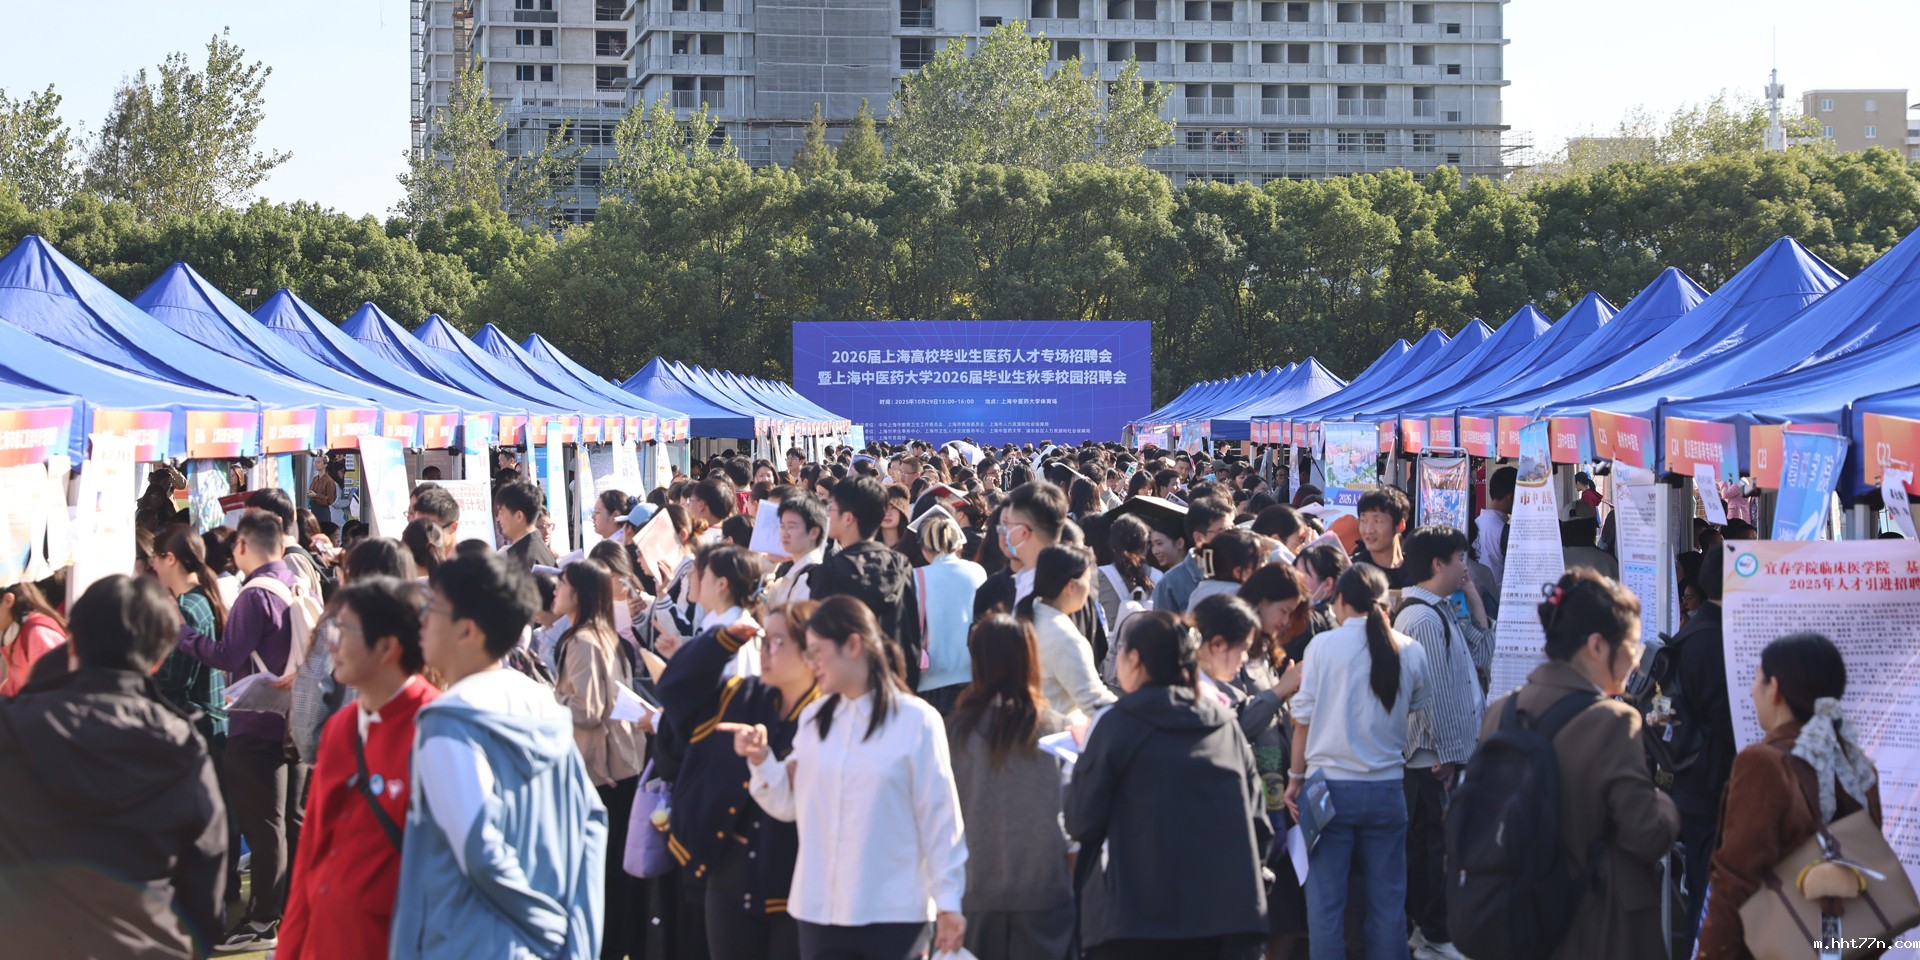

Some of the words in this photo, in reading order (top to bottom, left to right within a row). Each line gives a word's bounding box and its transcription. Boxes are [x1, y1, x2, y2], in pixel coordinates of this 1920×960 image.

[832, 349, 1113, 364] 2026届上海高校毕业生医药人才专场招聘会
[817, 370, 1127, 385] 暨上海中医药大学2026届毕业生秋季校园招聘会
[1764, 560, 1919, 575] 宜春学院临床医学院、基
[1789, 577, 1920, 591] 2025年人才引进招聘
